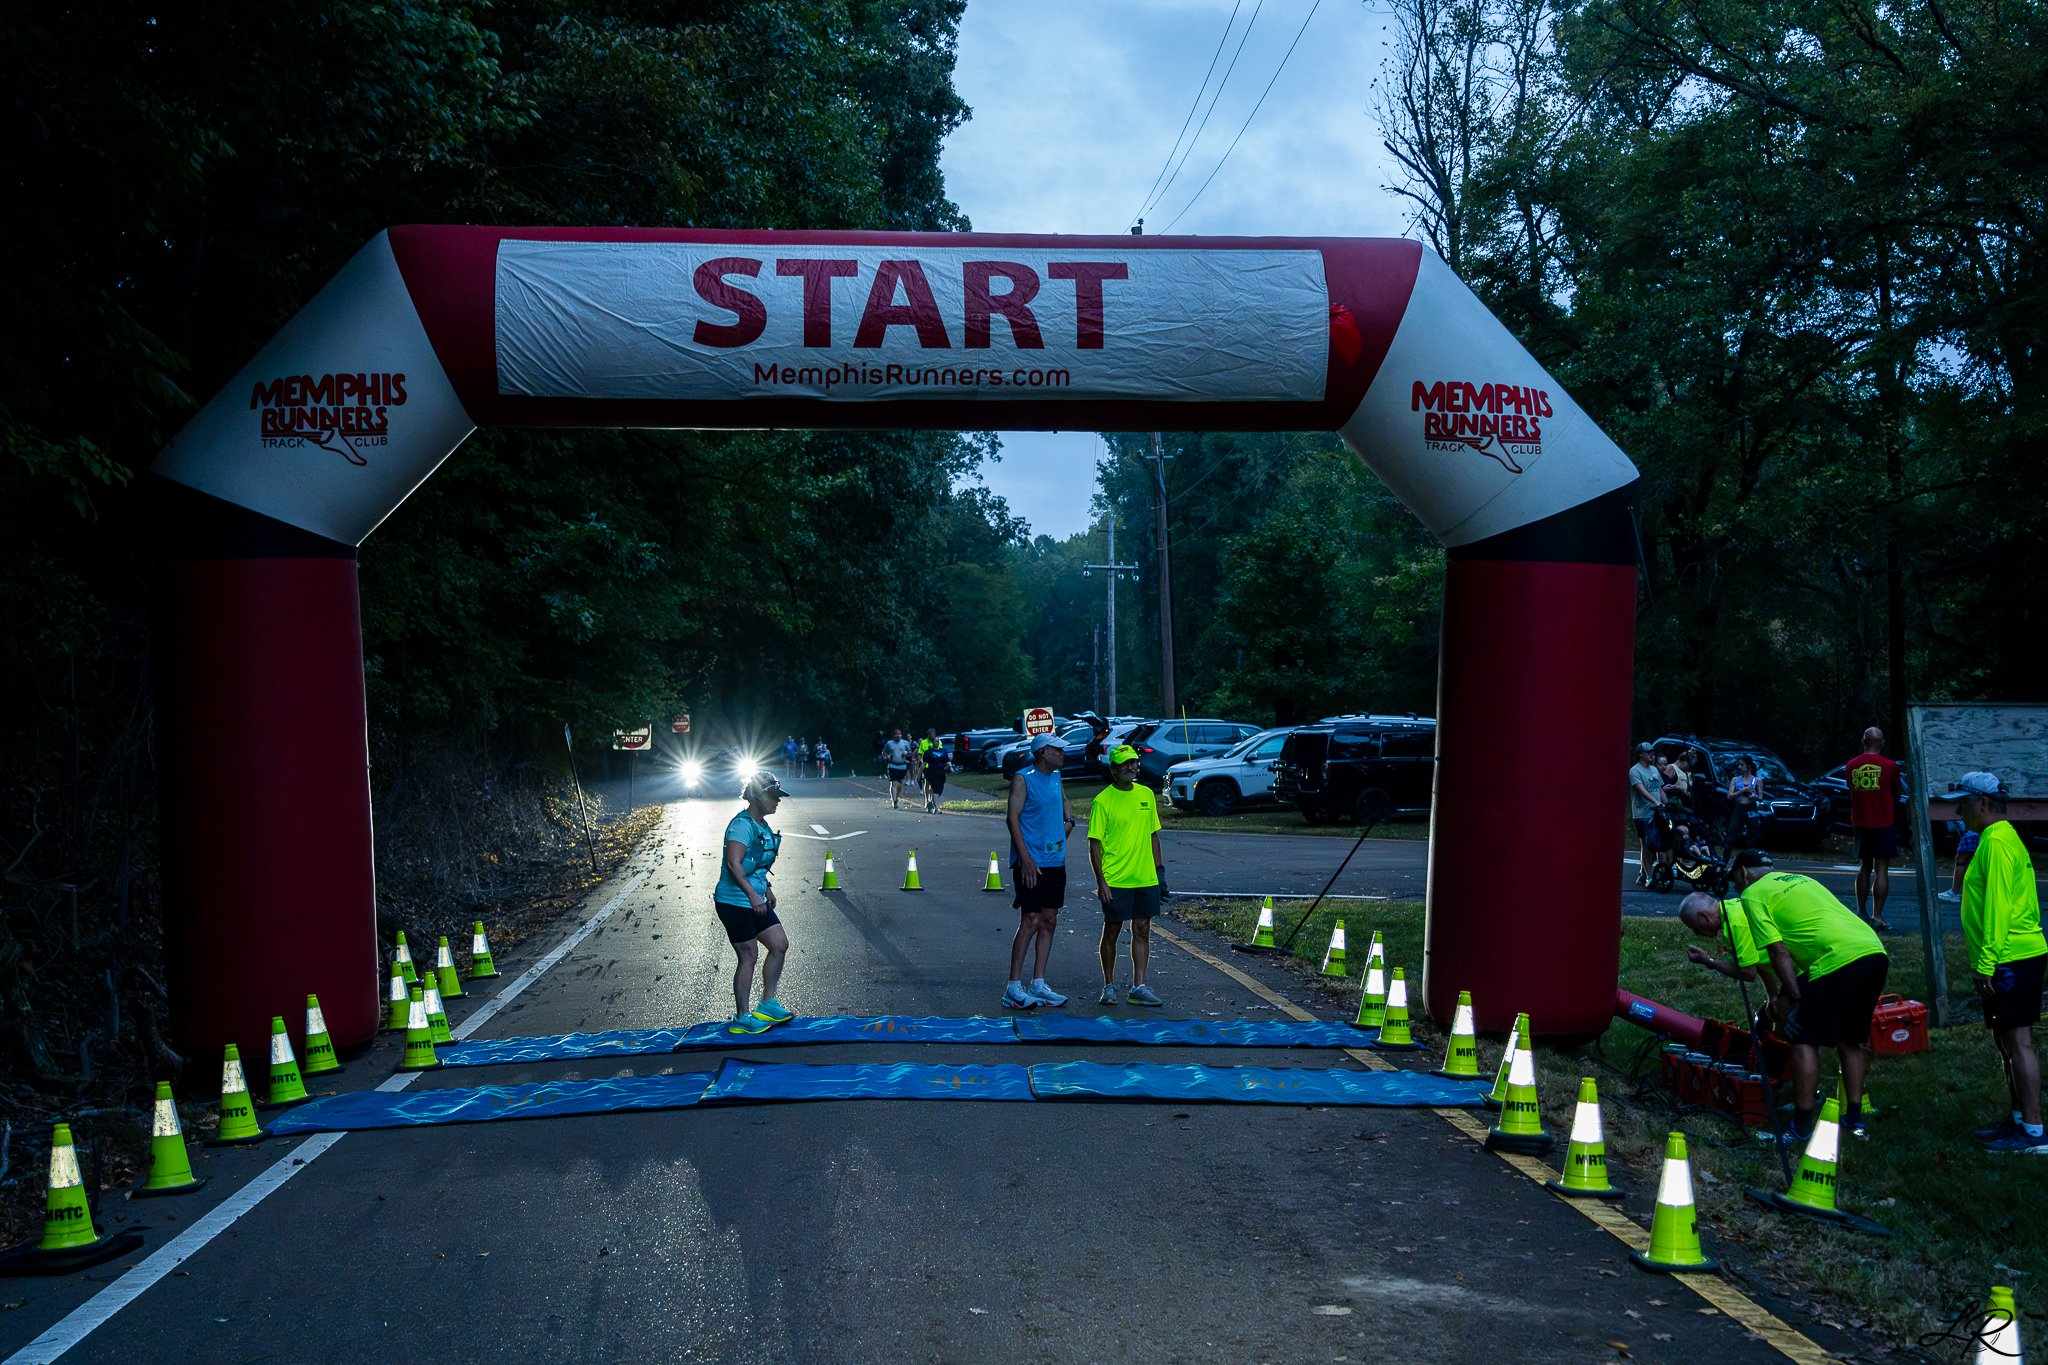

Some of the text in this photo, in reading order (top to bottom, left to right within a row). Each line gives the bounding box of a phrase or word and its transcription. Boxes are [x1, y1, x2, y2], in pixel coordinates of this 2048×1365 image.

[692, 257, 1128, 350] START
[754, 362, 1071, 390] MemphisRunners.com
[250, 373, 407, 410] MEMPHIS
[1411, 380, 1553, 418] MEMPHIS
[262, 406, 388, 433] RUNNERS
[1424, 412, 1542, 439] RUNNERS
[262, 437, 388, 449] TRACK CLUB
[1425, 441, 1542, 455] TRACK CLUB
[1032, 726, 1049, 734] ENTER
[429, 1019, 446, 1029] RTC
[407, 1040, 432, 1051] MRTC
[1505, 1100, 1537, 1113] MRTC
